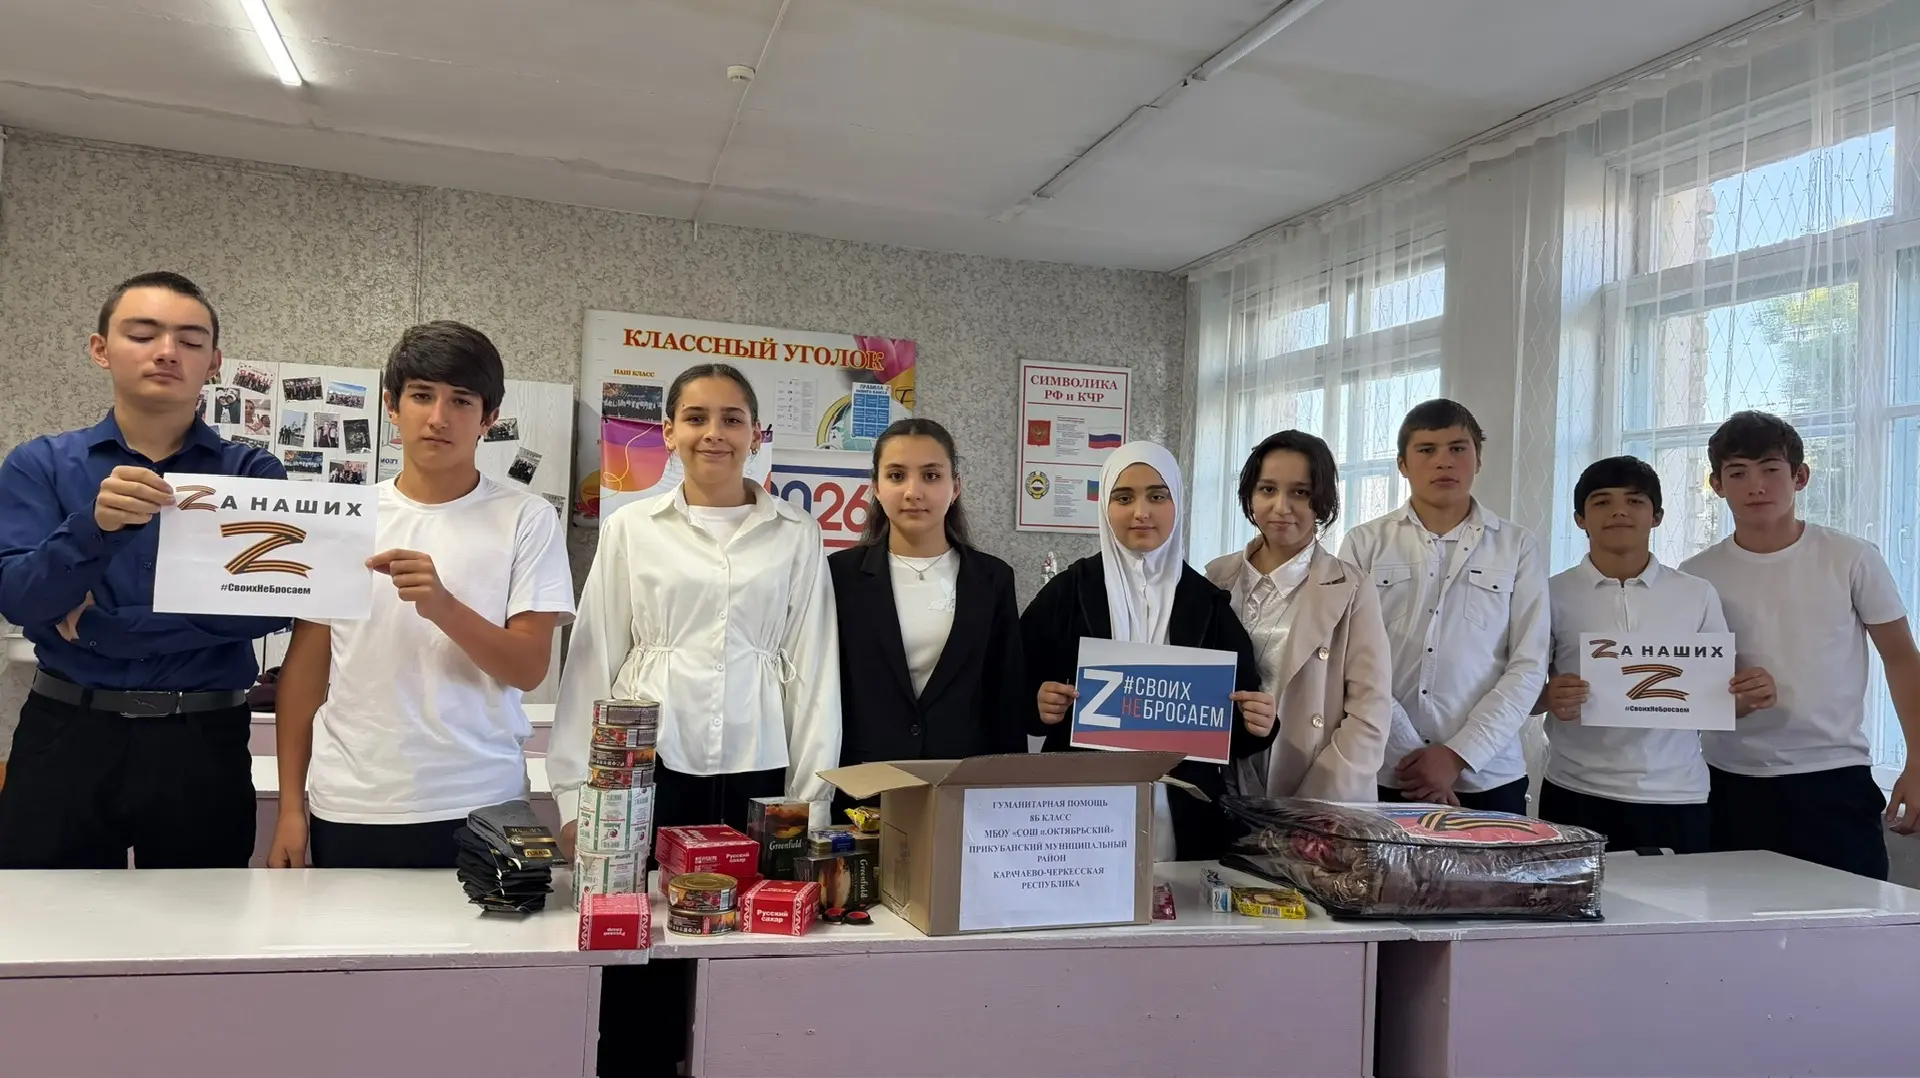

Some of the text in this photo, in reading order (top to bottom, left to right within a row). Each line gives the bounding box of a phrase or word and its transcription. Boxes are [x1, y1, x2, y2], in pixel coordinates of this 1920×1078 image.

[623, 328, 884, 371] КЛАССНЫЙ УГОЛОК
[613, 368, 656, 378] НАШ КЛАСС
[1030, 374, 1118, 390] СИМВОЛИКА
[1044, 389, 1105, 403] РФ и КЧР
[250, 495, 363, 517] НАШИХ
[771, 480, 870, 533] 026
[220, 583, 311, 595] #СвоихНеБросаем
[1641, 645, 1724, 658] НАШИХ
[1123, 675, 1192, 701] #СВОИХ
[1078, 668, 1124, 729] Z
[1121, 696, 1225, 728] НЕБРОСАЕМ
[1624, 705, 1690, 713] #СвоихНеБросаем
[992, 799, 1108, 809] ГУМАНИТАРНАЯ ПОМОЩЬ
[1029, 813, 1072, 822] 8Б КЛАСС
[984, 828, 1010, 839] МБОУ
[1012, 828, 1038, 838] «СОШ
[769, 839, 803, 850] Greenfield
[969, 840, 1128, 854] ПРИКУБАНСКИЙ МУНИЦИПАЛЬНЫЙ
[1037, 854, 1067, 863] РАЙОН
[859, 858, 868, 899] Greenfield
[993, 867, 1105, 879] КАРАЧАЕВО-ЧЕРКЕССКАЯ
[1021, 880, 1081, 890] РЕСПУБЛИКА
[756, 909, 789, 917] Русский
[761, 916, 784, 924] сахар
